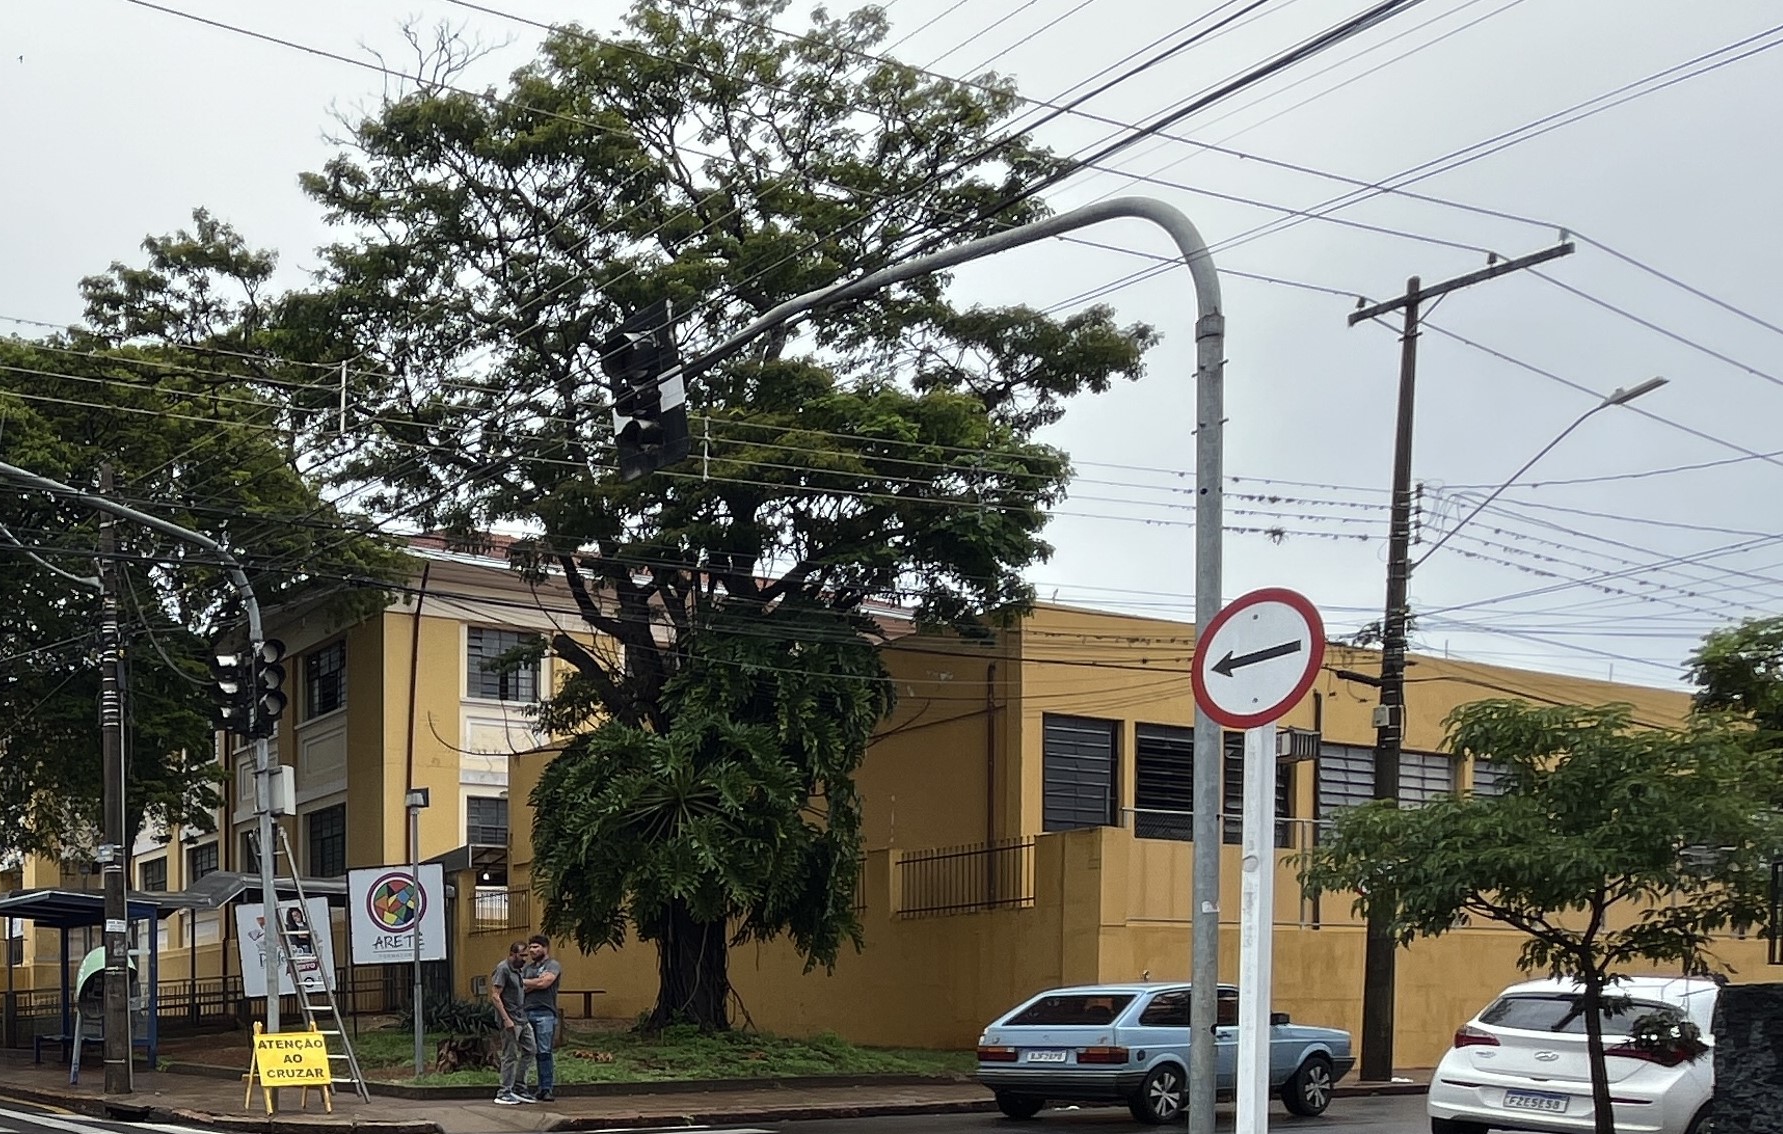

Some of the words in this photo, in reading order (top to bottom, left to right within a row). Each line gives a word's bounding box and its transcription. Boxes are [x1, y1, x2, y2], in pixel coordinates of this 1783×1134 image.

[258, 1039, 323, 1050] ATENÇÃO
[283, 1054, 303, 1064] AO
[267, 1068, 325, 1079] CRUZAR
